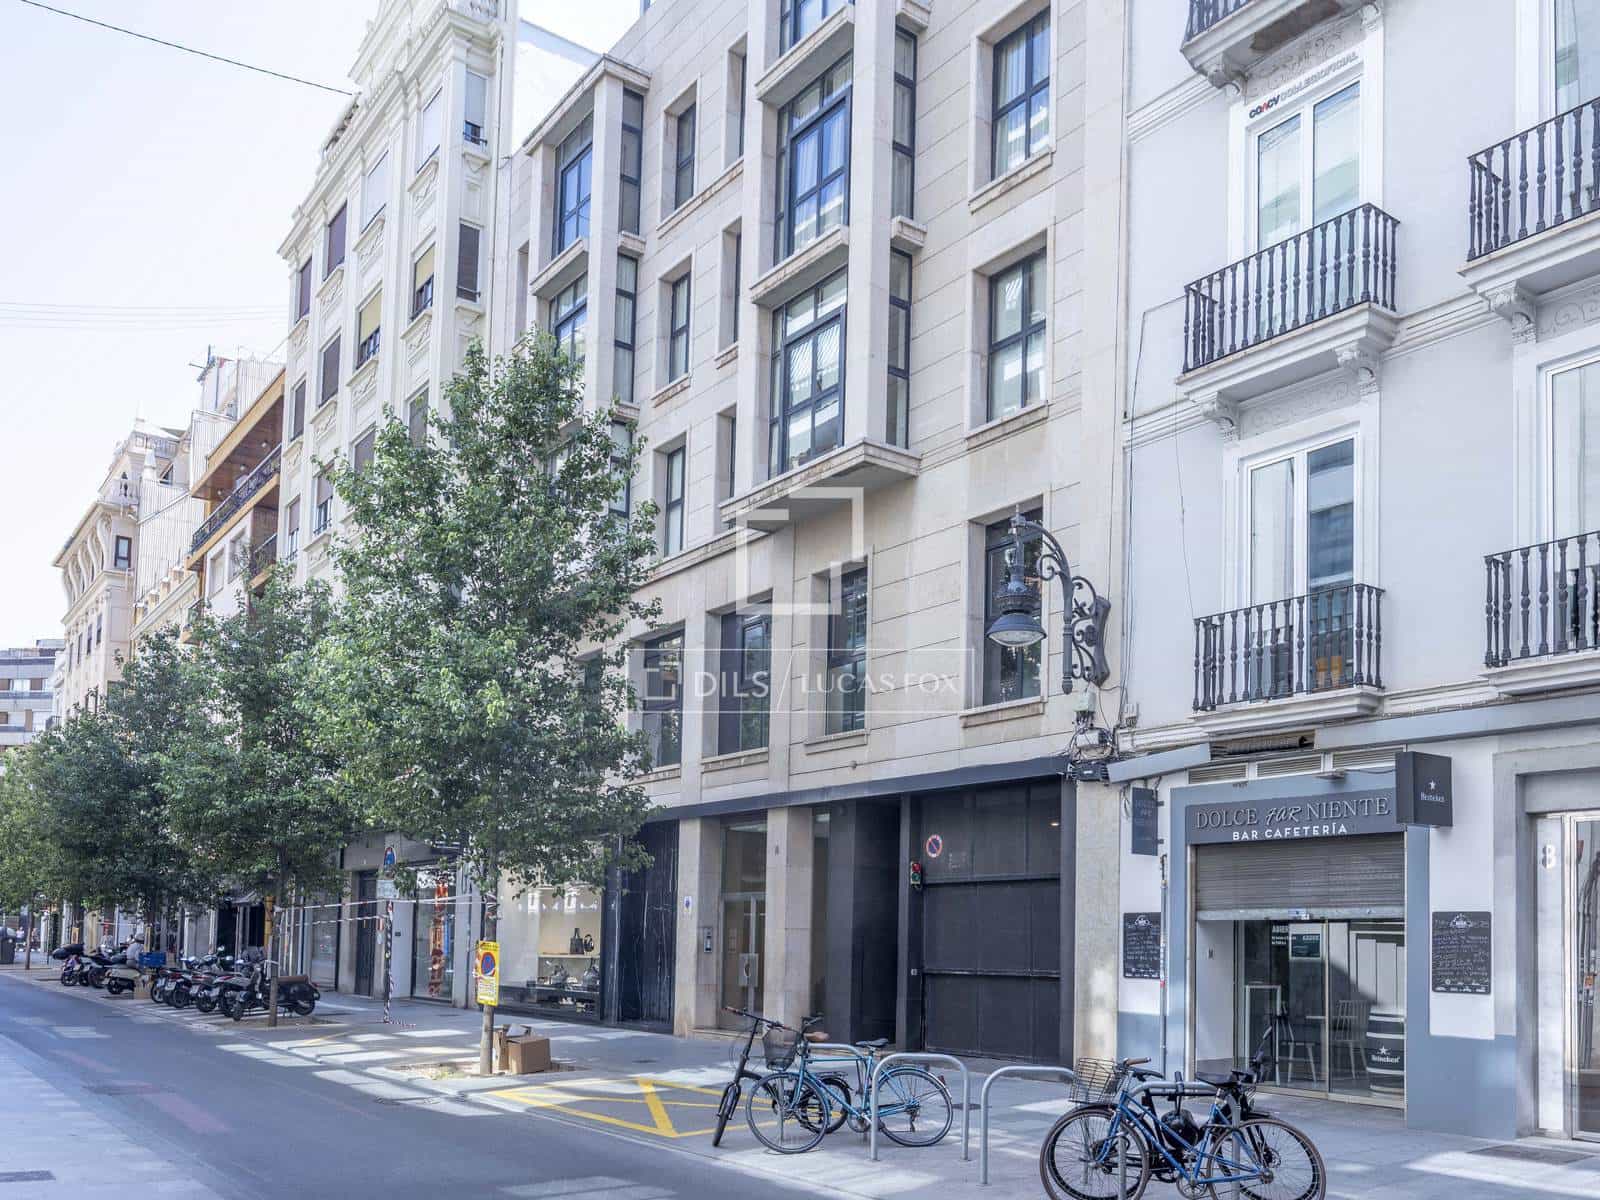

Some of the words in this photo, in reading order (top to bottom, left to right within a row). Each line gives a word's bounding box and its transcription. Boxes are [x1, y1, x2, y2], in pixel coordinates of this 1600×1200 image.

[1197, 808, 1258, 829] DOLCE
[1306, 797, 1391, 821] NIENTE
[1232, 830, 1258, 841] BAR
[1542, 844, 1556, 869] 8
